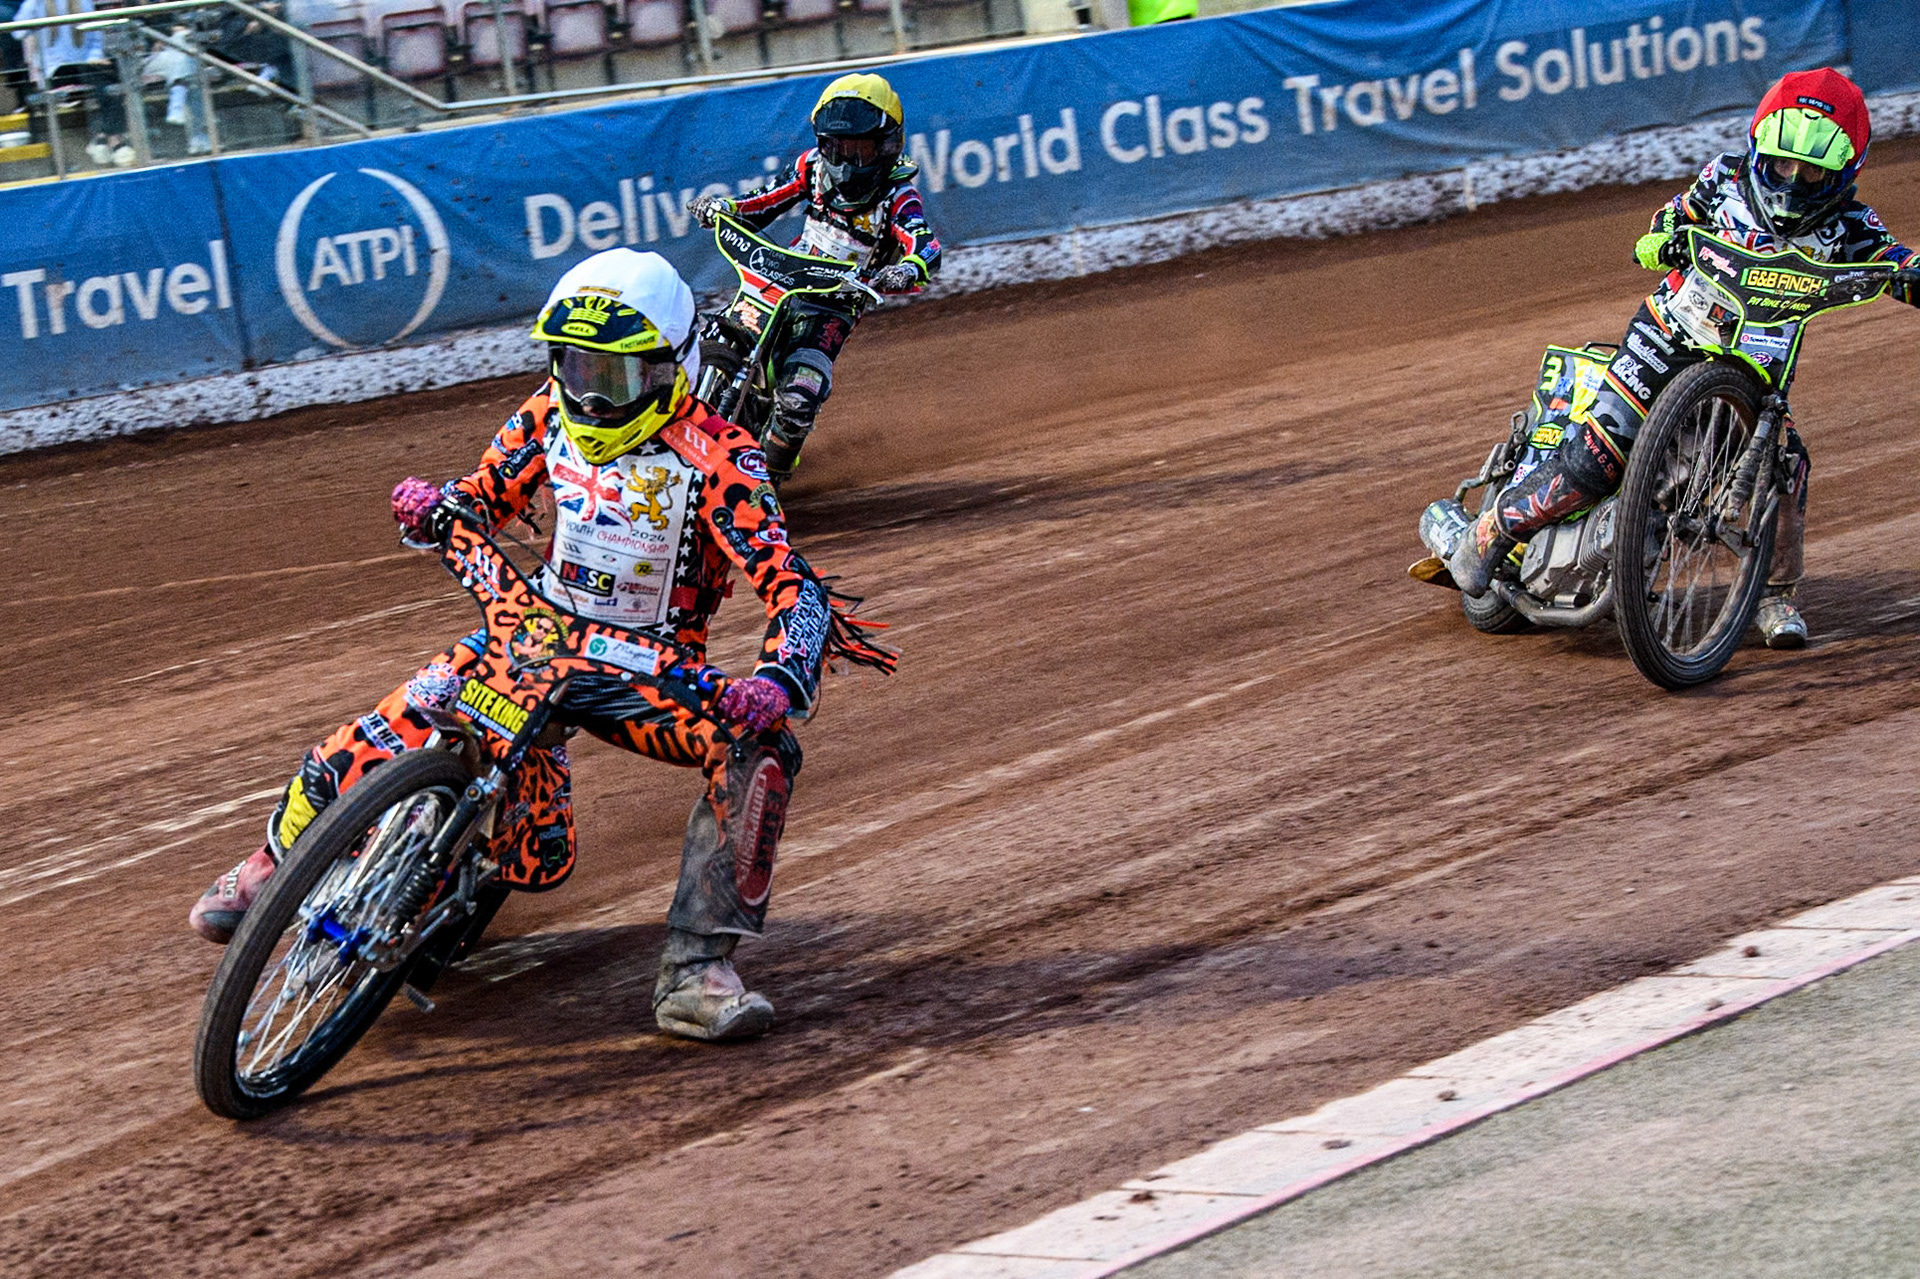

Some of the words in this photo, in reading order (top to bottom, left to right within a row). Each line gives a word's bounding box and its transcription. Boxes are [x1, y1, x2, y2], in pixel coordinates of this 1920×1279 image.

[524, 153, 802, 260] Deliv
[908, 106, 1082, 193] World
[1101, 95, 1270, 164] Class
[1283, 47, 1478, 135] Travel
[1496, 15, 1767, 102] Solutions
[308, 225, 418, 292] ATPI
[1, 239, 233, 339] Travel
[1747, 269, 1779, 288] G&B
[1777, 273, 1823, 295] FINCH
[567, 325, 591, 335] BELL
[1540, 356, 1563, 391] 3
[1611, 363, 1652, 400] RACING
[565, 521, 596, 537] YOUTH
[596, 530, 670, 554] CHAMPIONSHIP
[631, 528, 666, 542] 2024
[561, 561, 612, 591] NSSC
